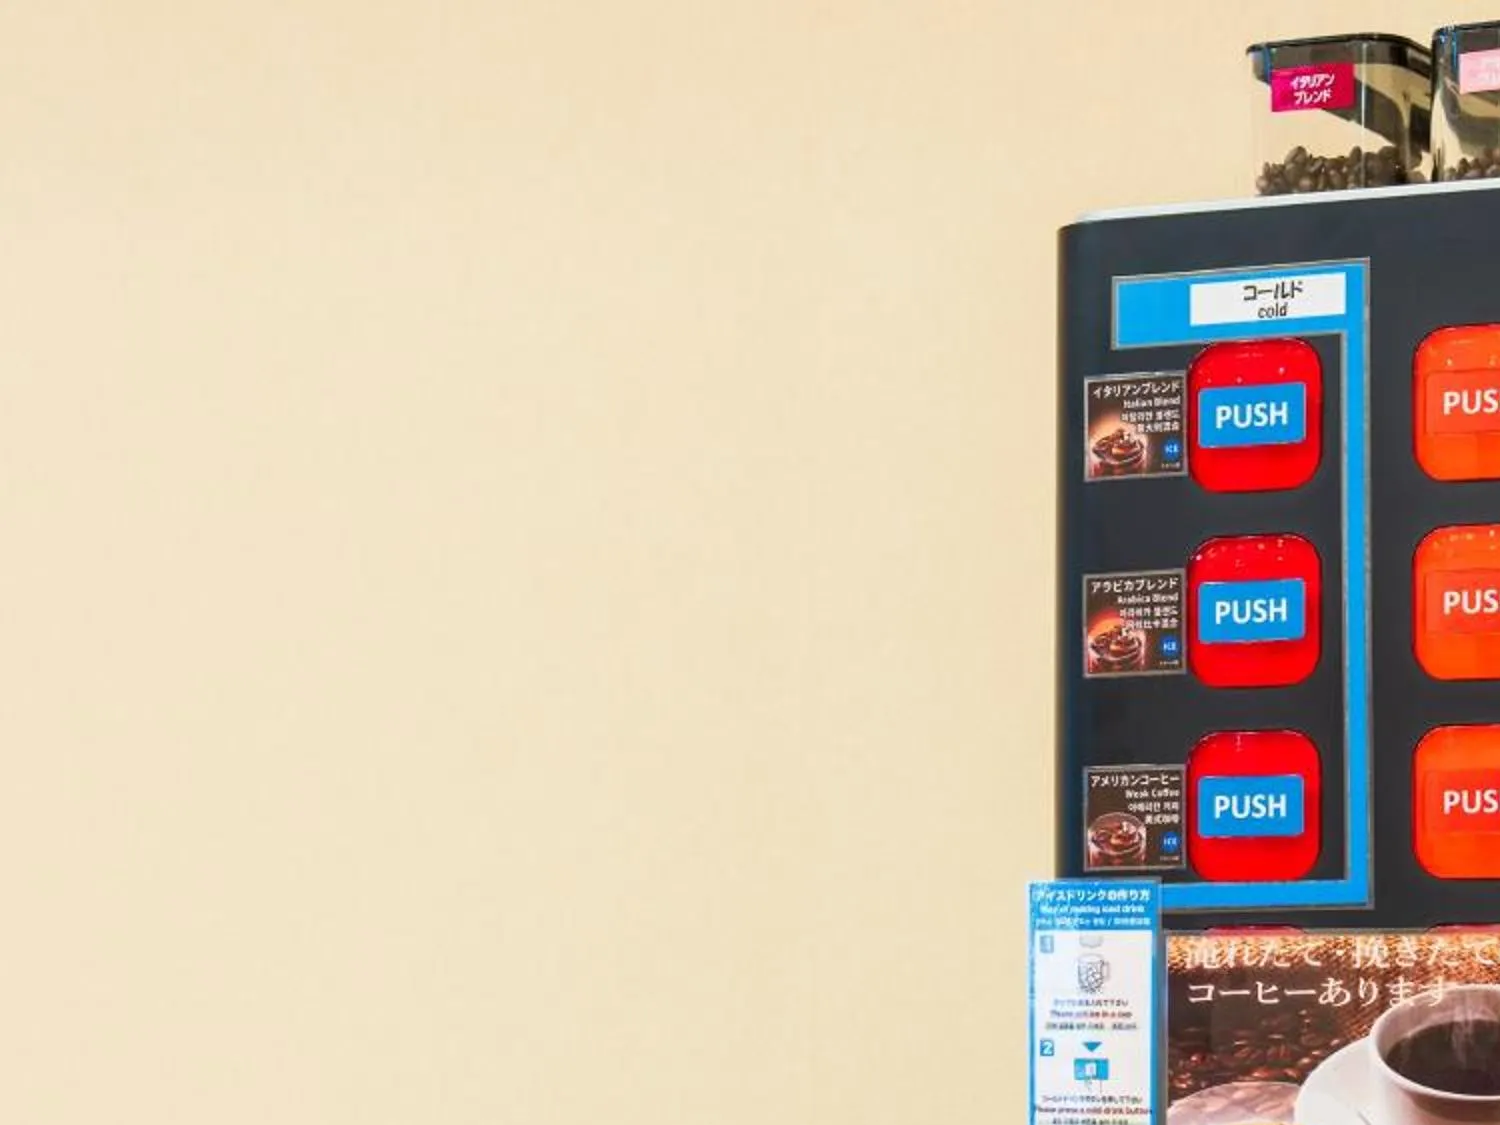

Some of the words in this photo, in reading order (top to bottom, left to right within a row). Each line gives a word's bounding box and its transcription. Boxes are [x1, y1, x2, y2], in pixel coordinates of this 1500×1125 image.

[1290, 72, 1335, 90] イタリアン
[1294, 88, 1332, 106] ブレンド
[1243, 280, 1303, 301] コールド
[1257, 302, 1288, 318] cold
[1093, 380, 1182, 399] イタリアンブレンド
[1215, 401, 1288, 430] PUSH
[1091, 577, 1179, 594] アラビカブレンド
[1215, 597, 1287, 625] PUSH
[1090, 773, 1180, 788] アメリカンコーヒー
[1214, 793, 1287, 820] PUSH
[1188, 976, 1448, 1008] コーヒーあります
[1042, 1041, 1053, 1055] 2
